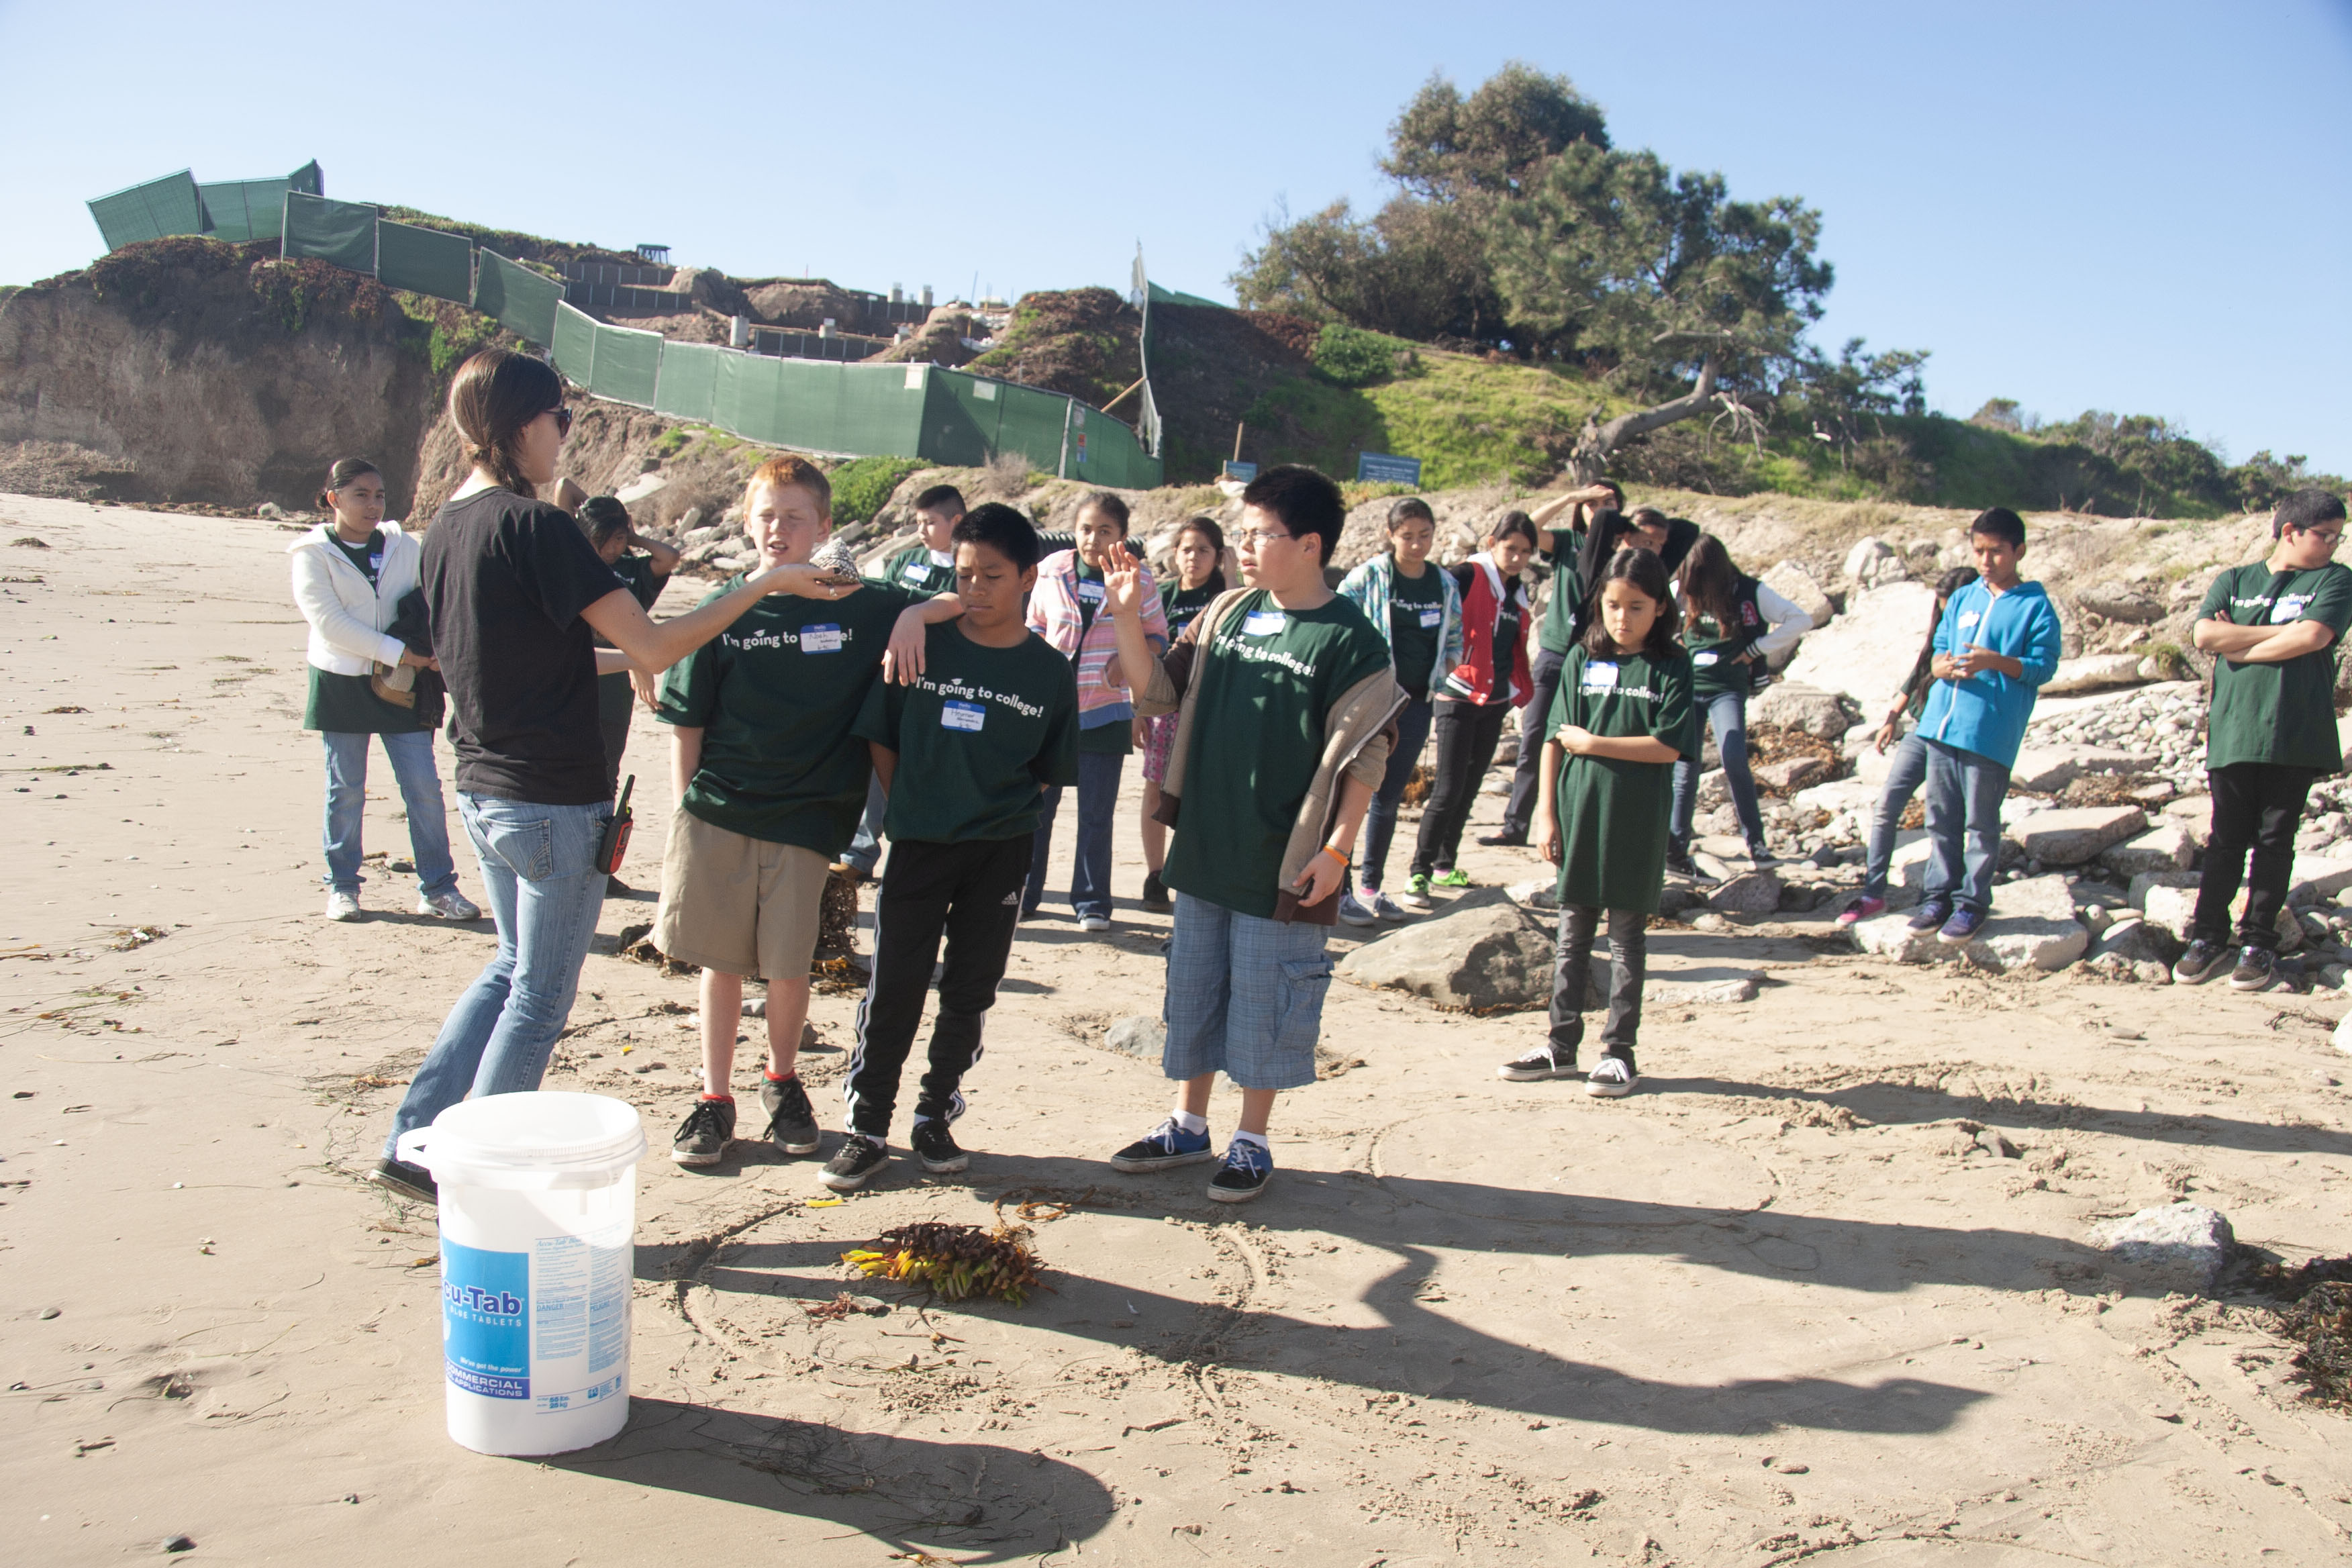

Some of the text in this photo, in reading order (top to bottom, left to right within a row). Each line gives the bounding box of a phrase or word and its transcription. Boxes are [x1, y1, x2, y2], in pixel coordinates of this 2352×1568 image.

[722, 631, 798, 650] I'm going to
[1255, 646, 1268, 660] to
[1267, 651, 1316, 677] college!
[916, 676, 1044, 718] I'm going to college!
[1582, 685, 1612, 697] going
[1612, 687, 1624, 695] to
[441, 1279, 522, 1316] cu-Tab
[536, 1304, 565, 1312] DANGER
[450, 1304, 522, 1327] BLUE TABLETS
[446, 1360, 522, 1389] COMMERCIAL
[488, 1363, 498, 1371] the
[454, 1377, 523, 1397] APPLICATIONS
